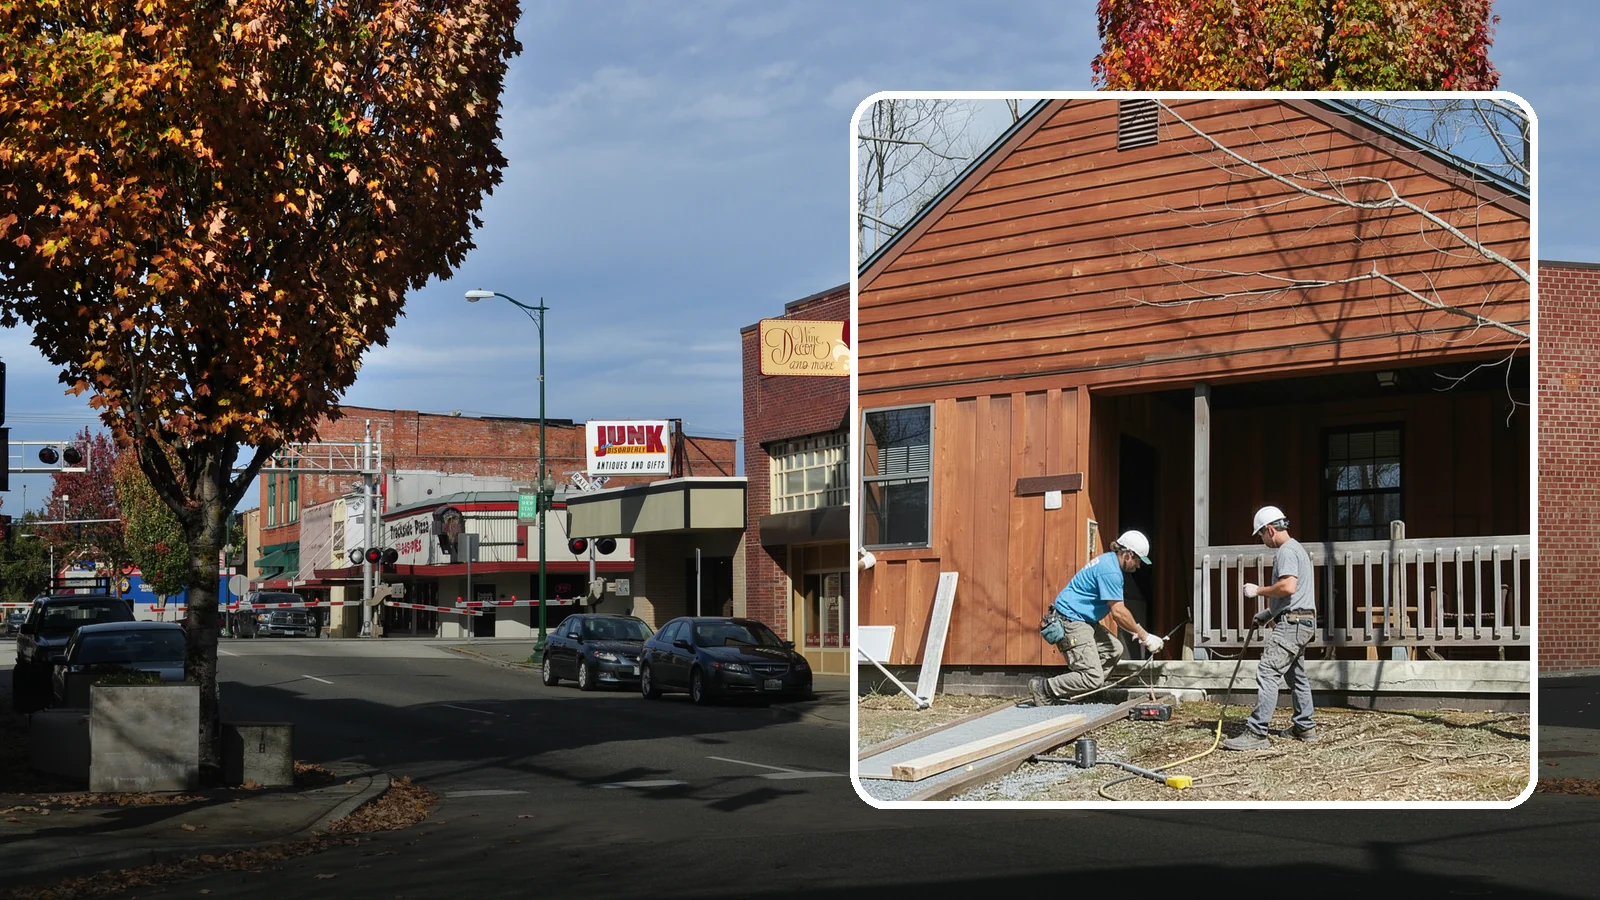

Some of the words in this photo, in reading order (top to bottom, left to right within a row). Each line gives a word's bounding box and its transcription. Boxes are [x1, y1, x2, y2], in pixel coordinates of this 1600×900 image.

[595, 425, 665, 457] JUNK
[607, 446, 646, 454] DISORDERLY
[597, 461, 628, 470] ANTIQUES
[631, 461, 643, 470] AND
[646, 460, 665, 470] GIFTS
[414, 519, 429, 534] Pizza
